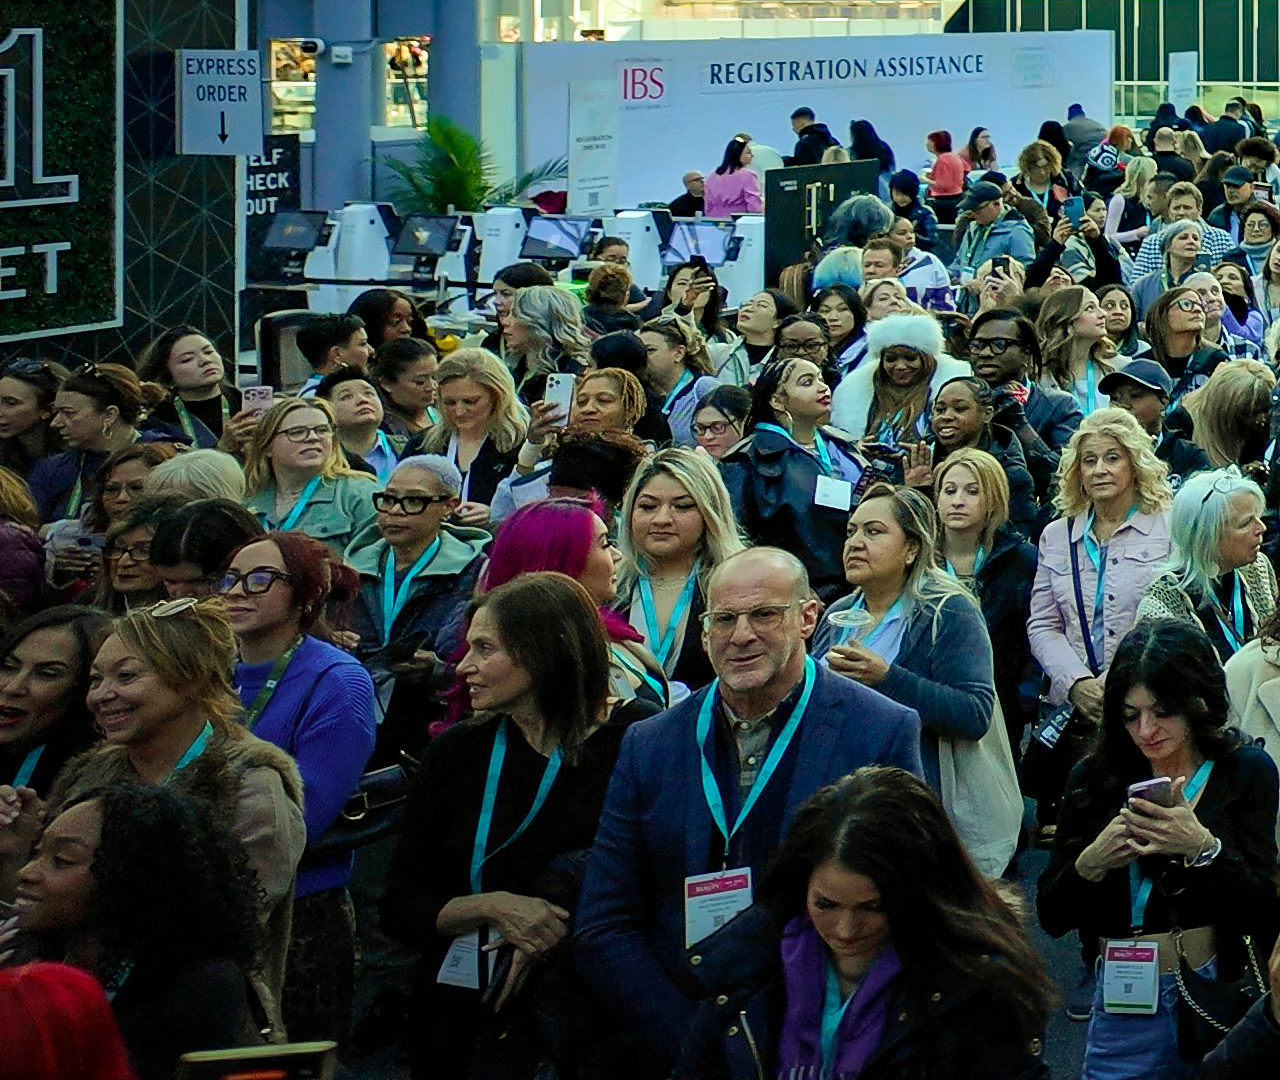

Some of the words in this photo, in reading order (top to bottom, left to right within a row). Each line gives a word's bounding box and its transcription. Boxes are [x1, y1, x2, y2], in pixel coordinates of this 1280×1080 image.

[186, 58, 257, 76] EXPRESS
[710, 57, 867, 86] REGISTRATION
[874, 54, 984, 77] ASSISTANCE
[623, 67, 665, 100] IBS
[196, 85, 248, 102] ORDER
[248, 148, 284, 167] ELF
[246, 172, 290, 191] HECK
